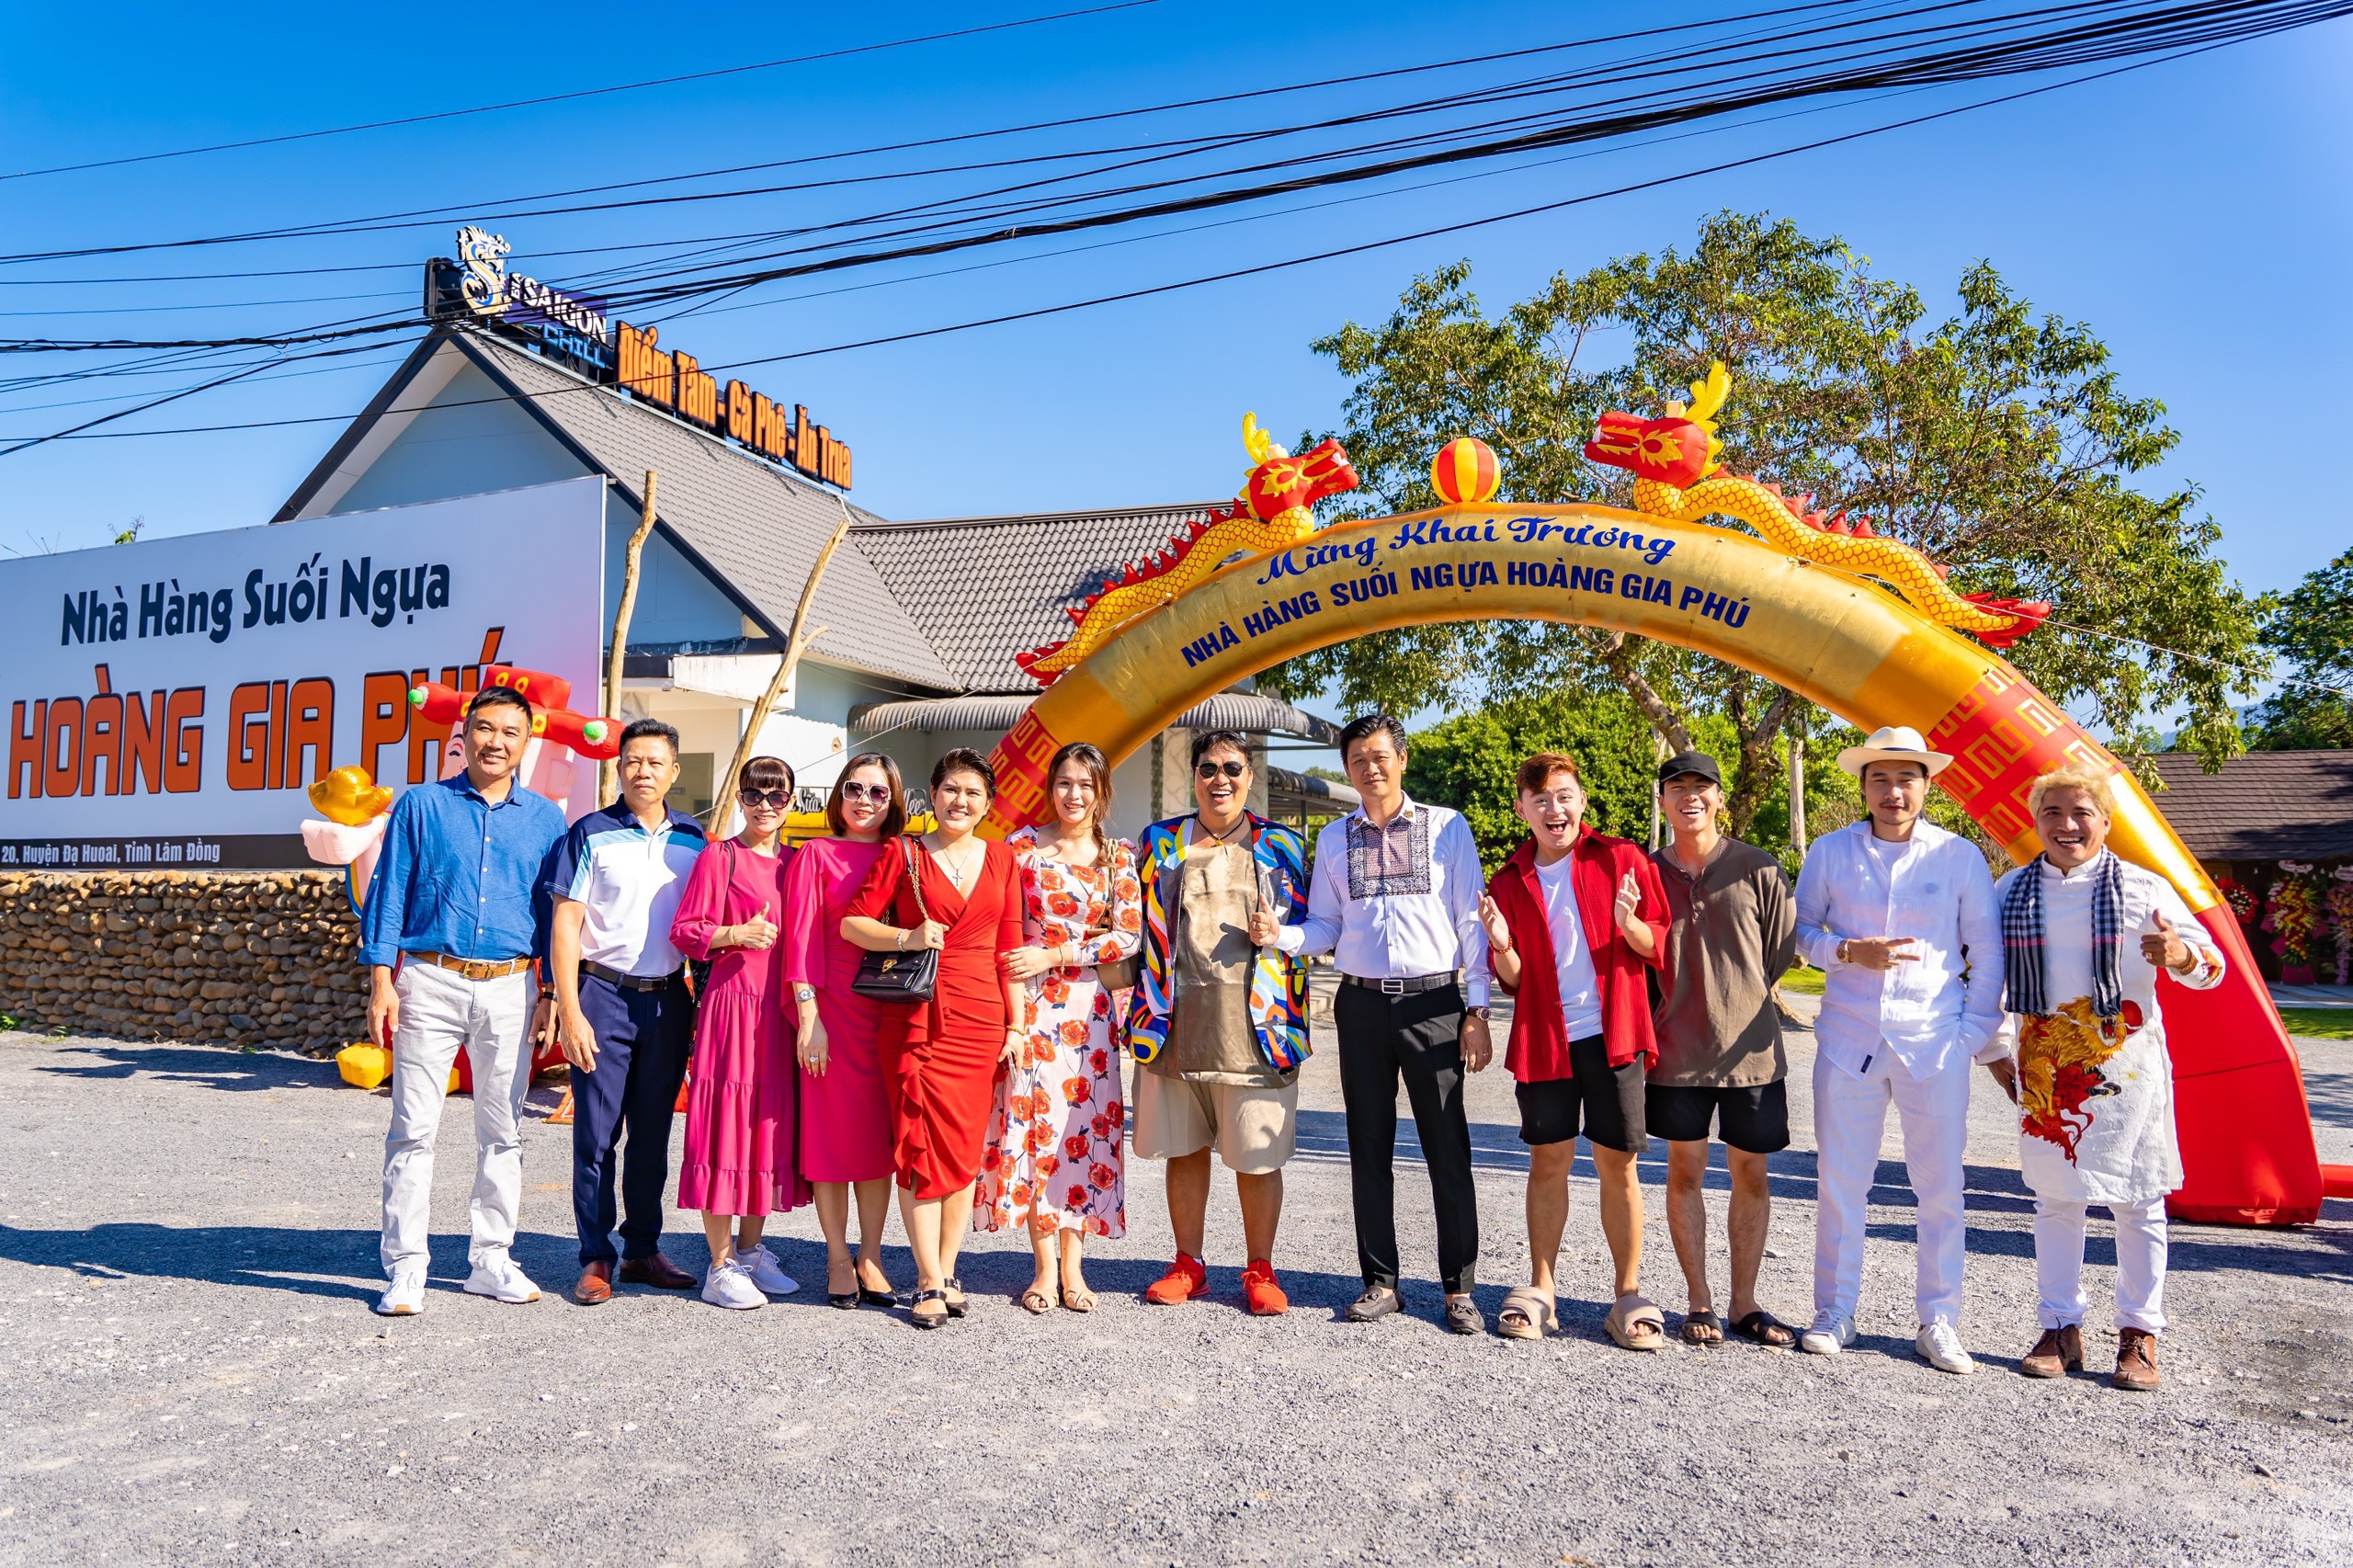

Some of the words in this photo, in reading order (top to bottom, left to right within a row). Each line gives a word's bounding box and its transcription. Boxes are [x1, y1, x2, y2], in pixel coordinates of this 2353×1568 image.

[522, 277, 608, 345] SAIGON
[542, 324, 606, 368] CHILL
[616, 320, 673, 406] Điểm
[673, 350, 717, 427] Tâm
[725, 379, 752, 444] Cà
[752, 392, 786, 459] Phê
[794, 404, 817, 473] Ăn
[1256, 537, 1379, 585] Mừng
[1388, 518, 1500, 550] Khai
[1506, 517, 1676, 565] Trương
[62, 585, 129, 645] Nhà
[138, 578, 233, 643] Hàng
[243, 552, 328, 629] Suối
[339, 556, 450, 628] Ngựa
[1180, 620, 1242, 668] NHÀ
[1242, 591, 1322, 638] HÀNG
[1329, 561, 1398, 607] SUỐI
[1410, 560, 1499, 594] NGỰA
[1507, 557, 1614, 595] HOÀNG
[1620, 573, 1672, 607] GIA
[1678, 585, 1751, 629] PHÚ
[7, 663, 205, 799] HOÀNG
[226, 676, 335, 790] GIA
[360, 626, 513, 784] PH
[1, 846, 19, 864] 20,
[22, 844, 59, 866] Huyện
[63, 845, 78, 866] Đạ
[82, 844, 120, 864] Huoai,
[125, 841, 152, 862] Tỉnh
[155, 842, 182, 862] Lâm
[186, 837, 221, 863] Đồng
